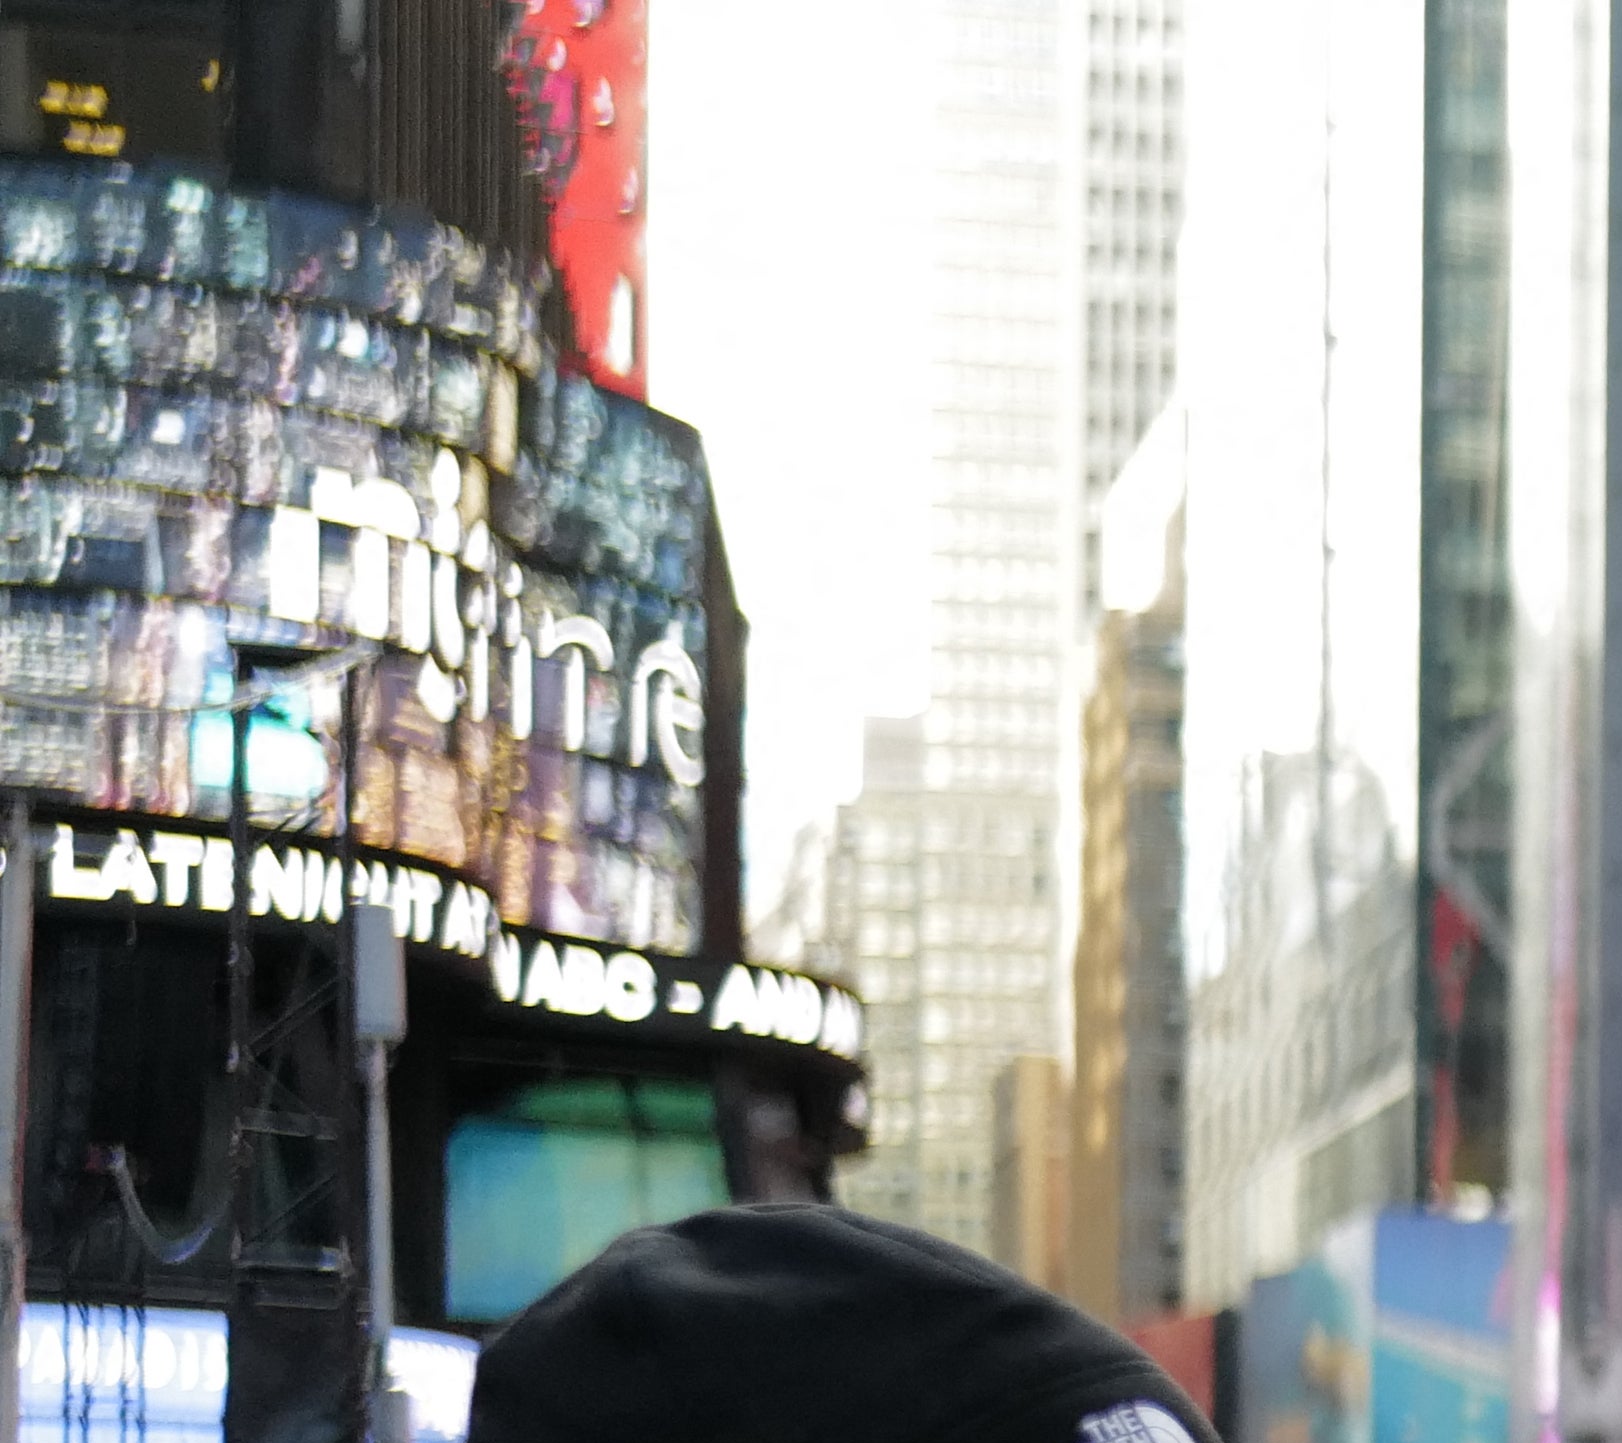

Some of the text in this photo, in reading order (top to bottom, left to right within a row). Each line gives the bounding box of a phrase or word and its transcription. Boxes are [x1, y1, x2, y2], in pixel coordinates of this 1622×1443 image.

[49, 821, 236, 912] LATE
[522, 938, 660, 1023] ABC
[1081, 1403, 1142, 1443] THE
